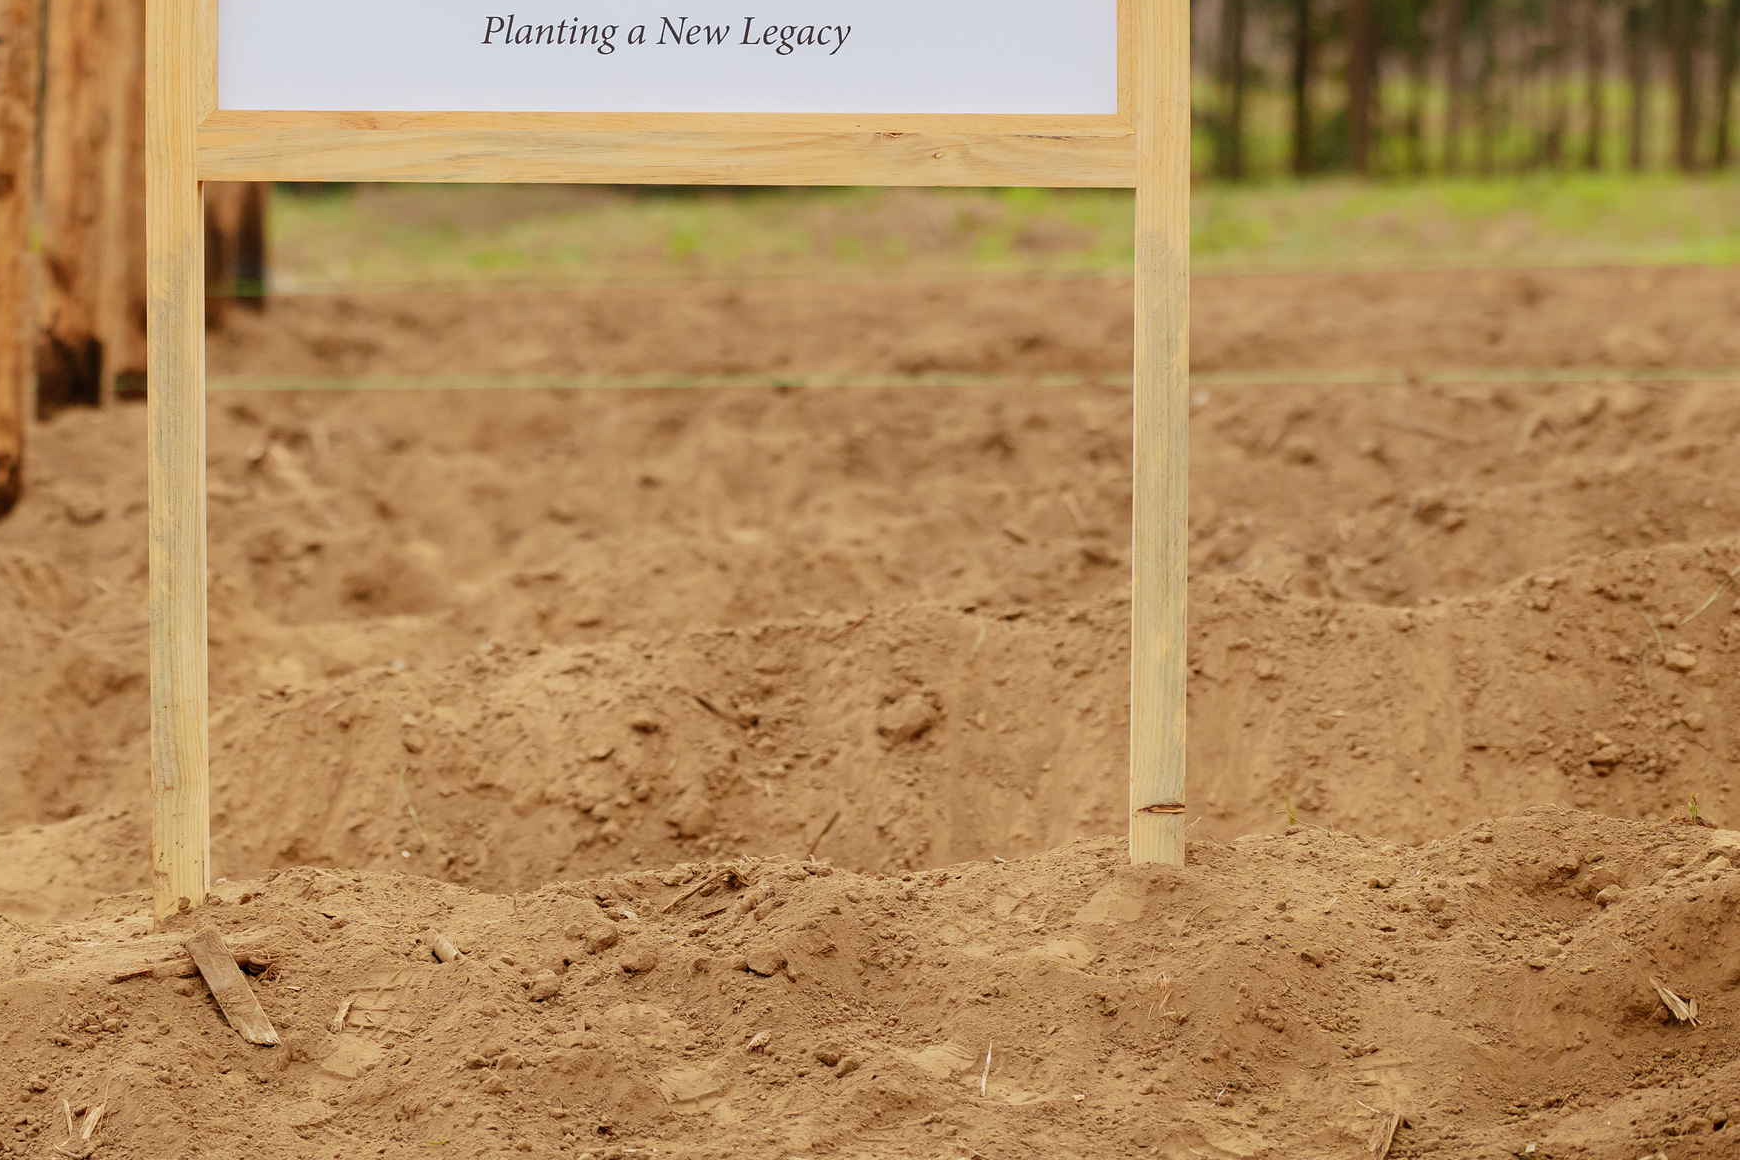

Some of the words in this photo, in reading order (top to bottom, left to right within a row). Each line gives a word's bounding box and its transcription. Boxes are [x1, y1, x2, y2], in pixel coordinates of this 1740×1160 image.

[480, 13, 620, 56] Planting
[627, 24, 647, 45] a
[655, 16, 731, 46] New
[738, 16, 852, 56] Legacy
